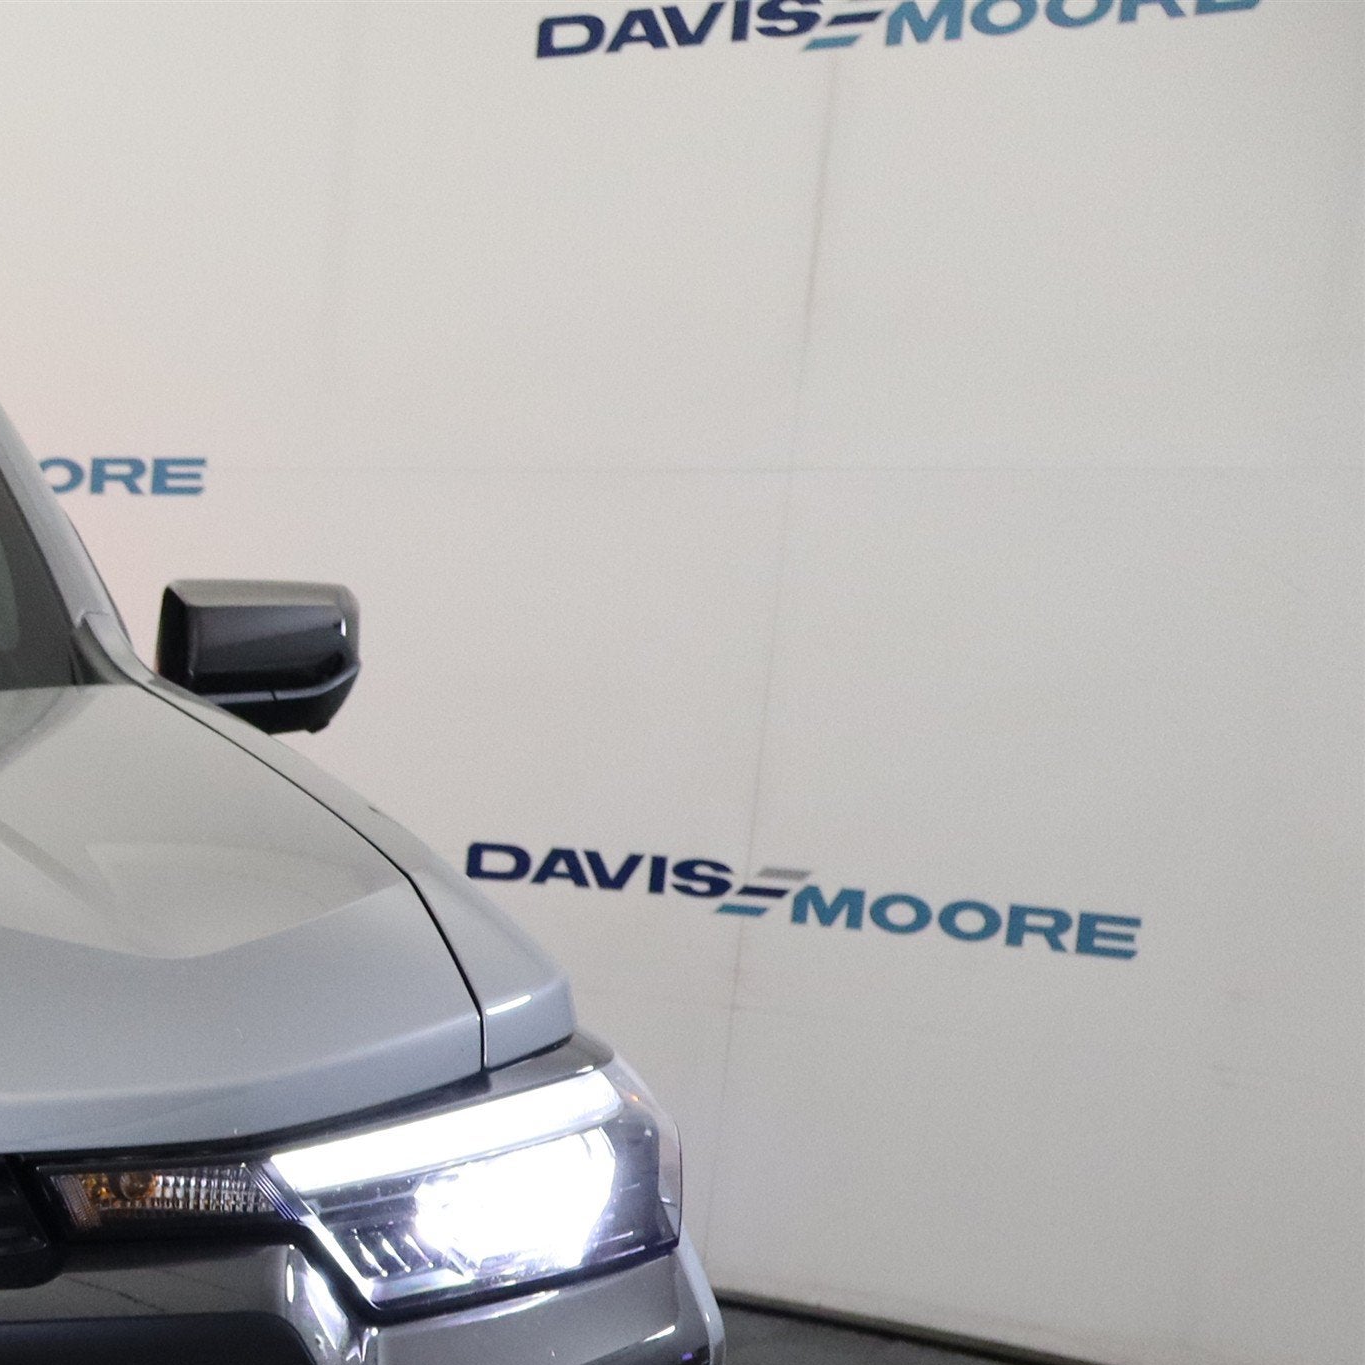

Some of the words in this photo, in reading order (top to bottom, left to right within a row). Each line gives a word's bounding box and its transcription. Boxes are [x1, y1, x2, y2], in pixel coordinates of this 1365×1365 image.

[537, 0, 820, 58] DAVIS
[39, 457, 207, 495] ORE
[466, 841, 733, 898] DAVIS
[790, 884, 1143, 960] MOORE
